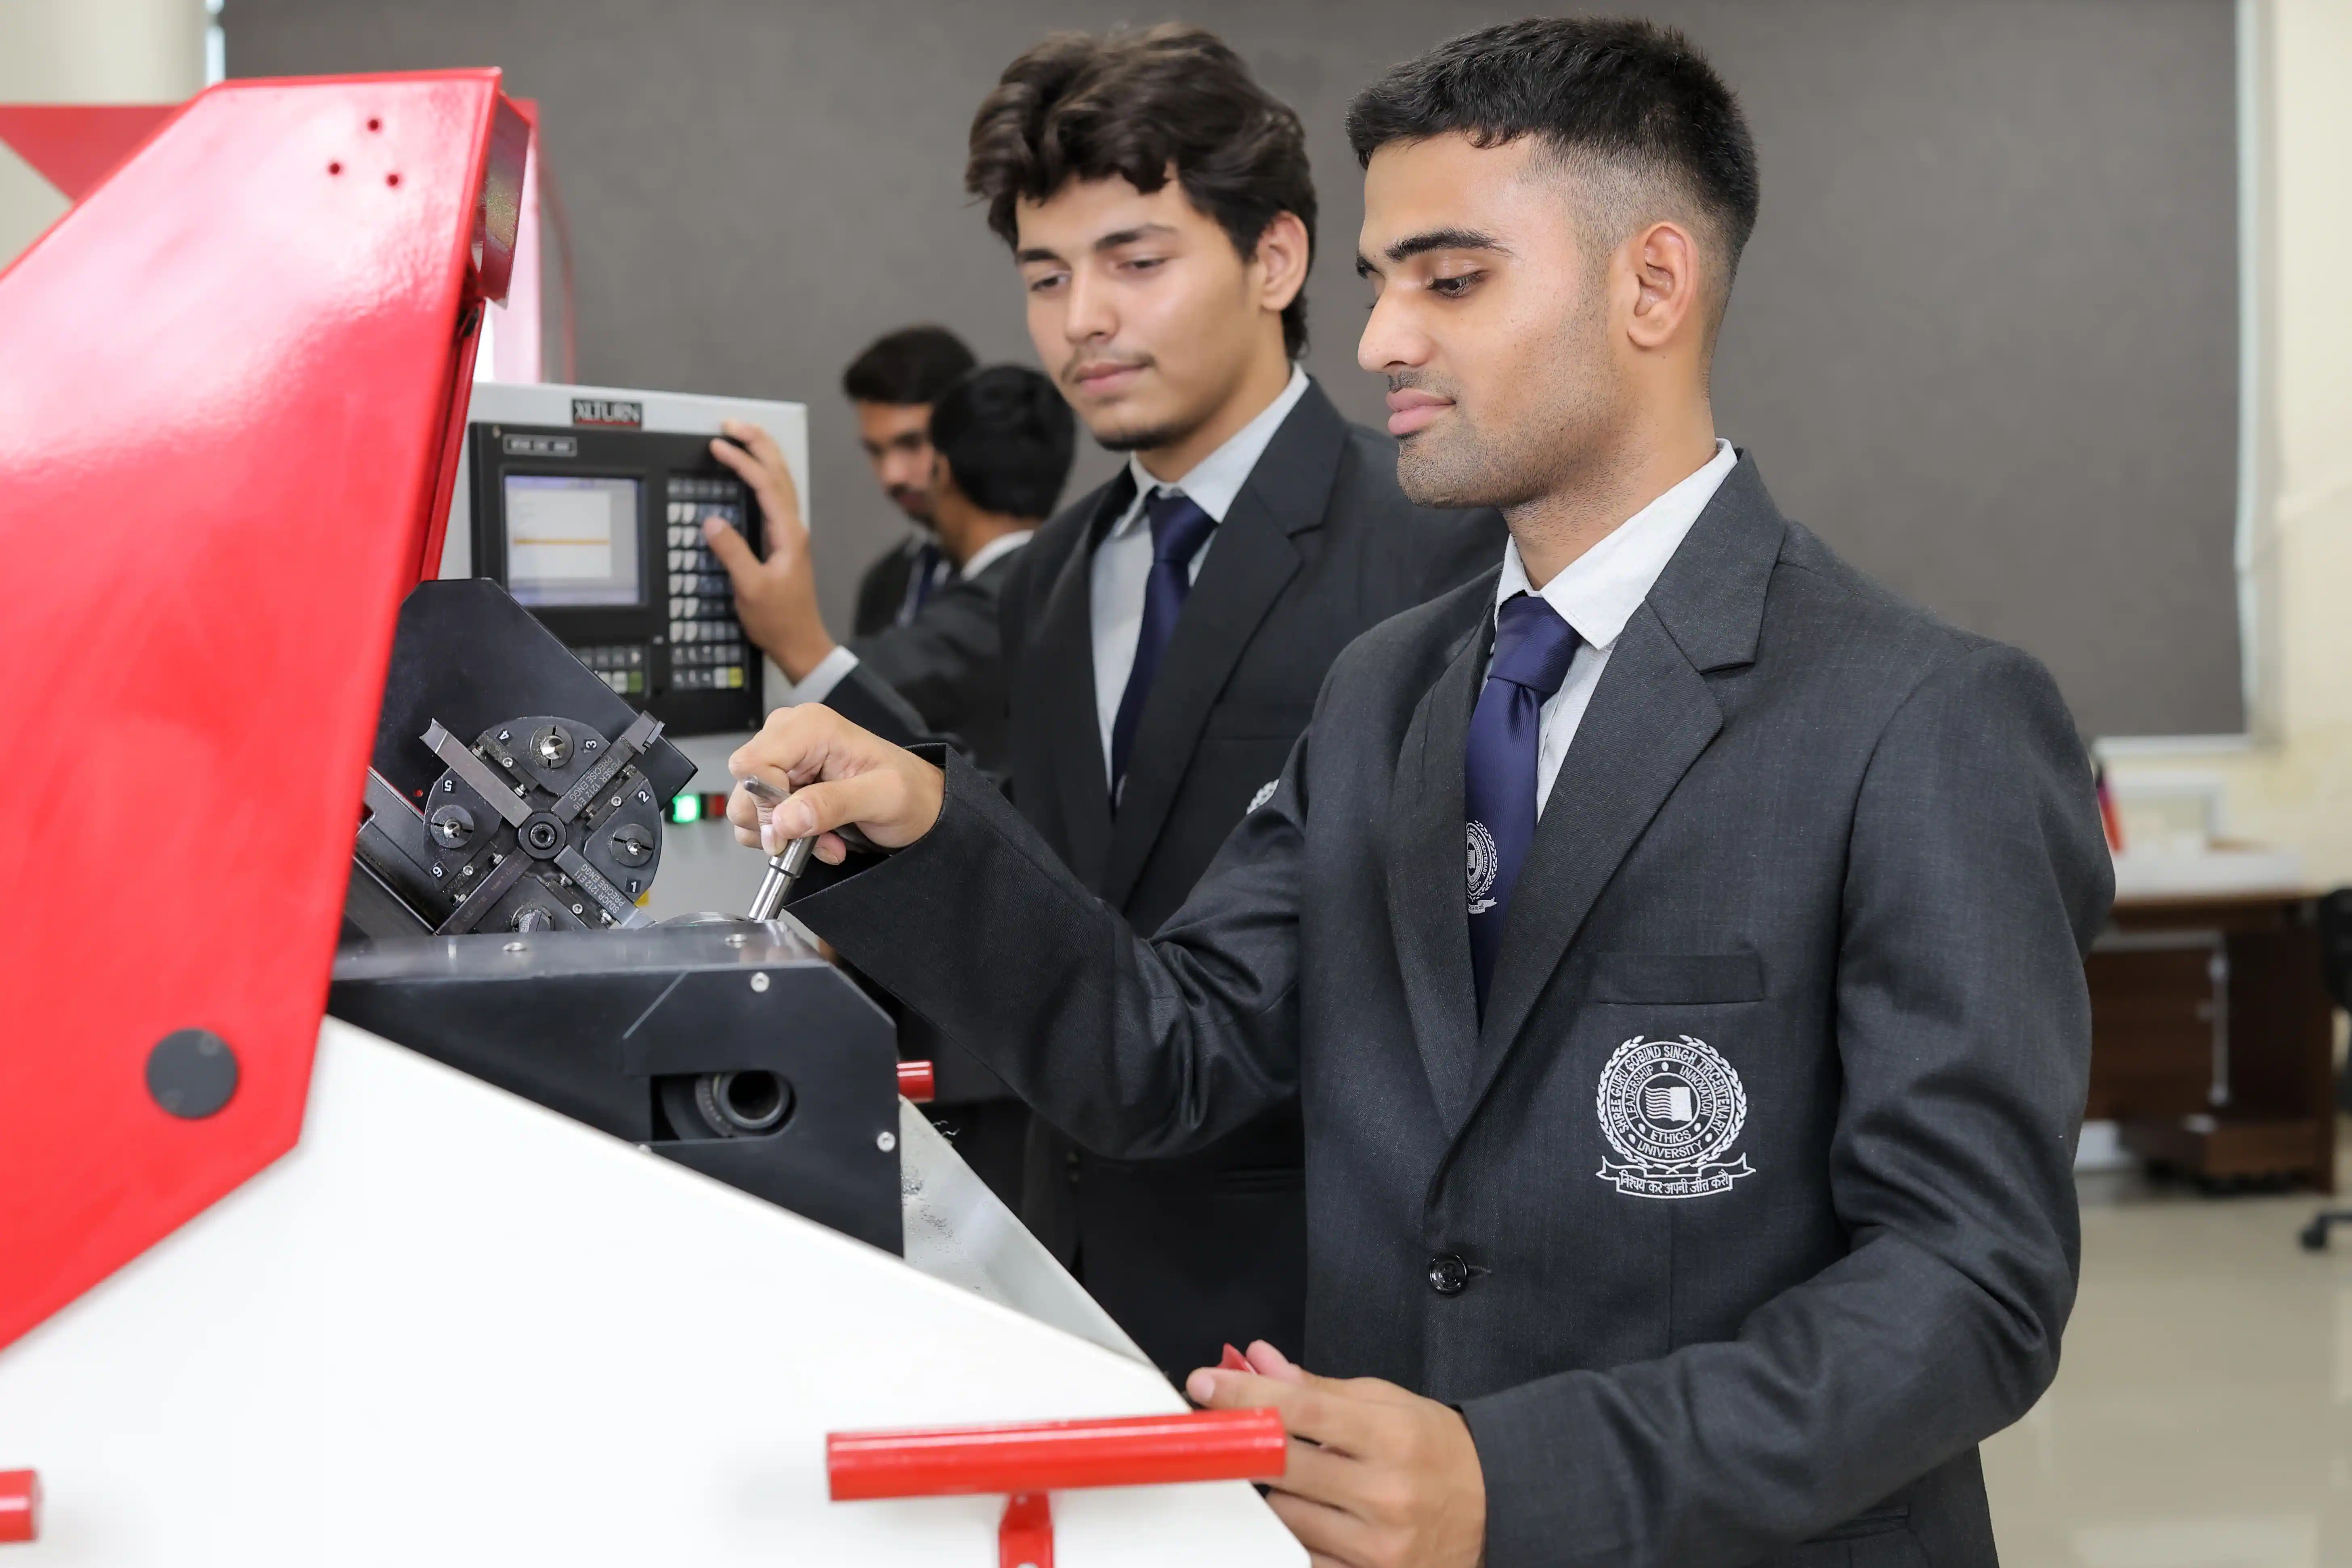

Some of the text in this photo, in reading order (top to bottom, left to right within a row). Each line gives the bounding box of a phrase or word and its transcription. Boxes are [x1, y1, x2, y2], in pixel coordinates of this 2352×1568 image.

[499, 730, 509, 740] 4
[585, 740, 597, 748] 3
[445, 780, 452, 791] 5
[569, 756, 613, 801] PRECISE ENGG
[585, 783, 600, 798] 1212
[638, 791, 649, 802] 2
[573, 797, 587, 811] E16
[574, 870, 619, 913] SDJCR 1212 E11
[581, 864, 625, 907] PRECISE ENGG
[631, 881, 637, 892] 1
[1611, 1045, 1730, 1135] SHREE GURU GOBIND SINGH TRICENTENARY
[1626, 1065, 1653, 1121] LEADERSHIP
[1679, 1065, 1712, 1116] INNOVATION
[1650, 1130, 1691, 1143] ETHICS
[1637, 1140, 1703, 1158] UNIVERSITY
[1646, 1180, 1662, 1194] कर
[1663, 1178, 1688, 1194] अपनी
[1688, 1177, 1709, 1192] जीत
